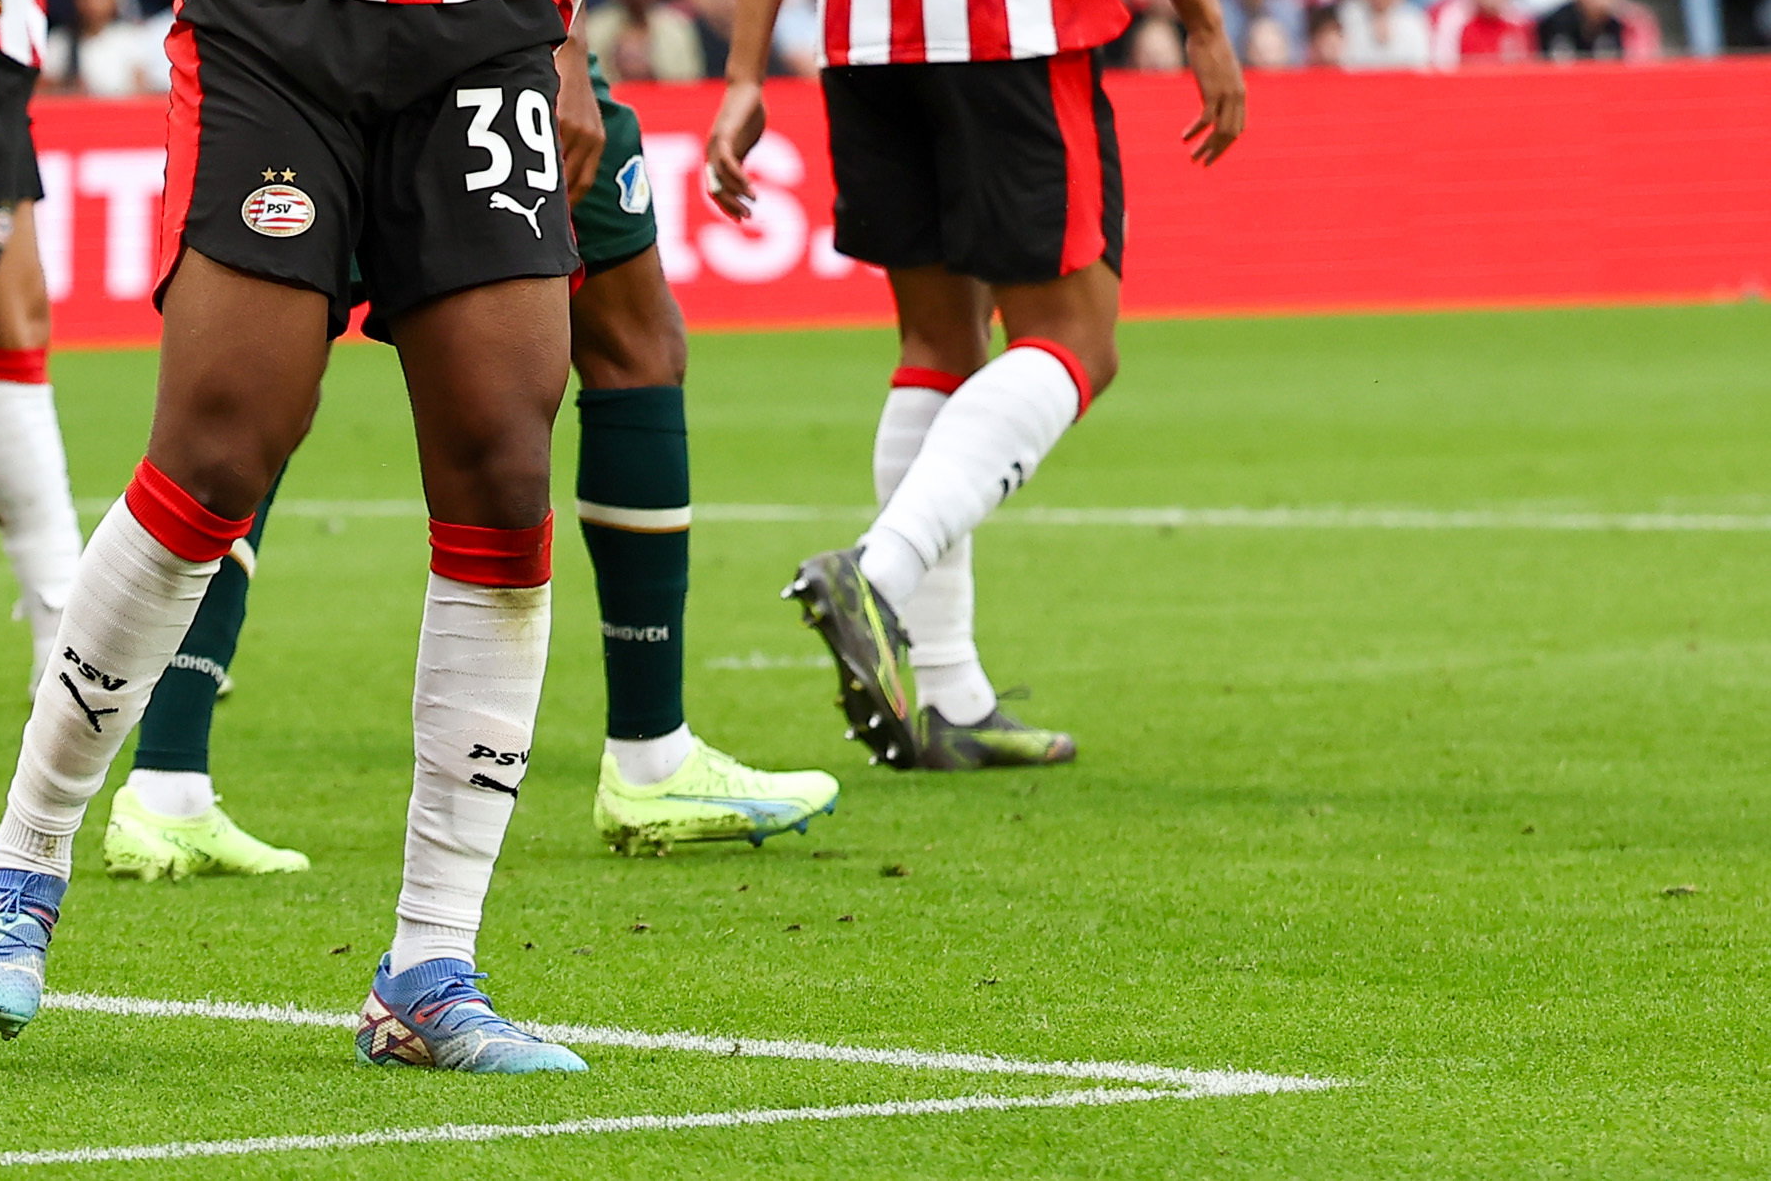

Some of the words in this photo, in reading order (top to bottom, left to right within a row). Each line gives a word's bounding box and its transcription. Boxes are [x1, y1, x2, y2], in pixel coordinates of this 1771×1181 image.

[456, 87, 559, 193] 39
[266, 203, 292, 214] PSV
[63, 646, 128, 691] PSV
[468, 743, 532, 766] PSV
